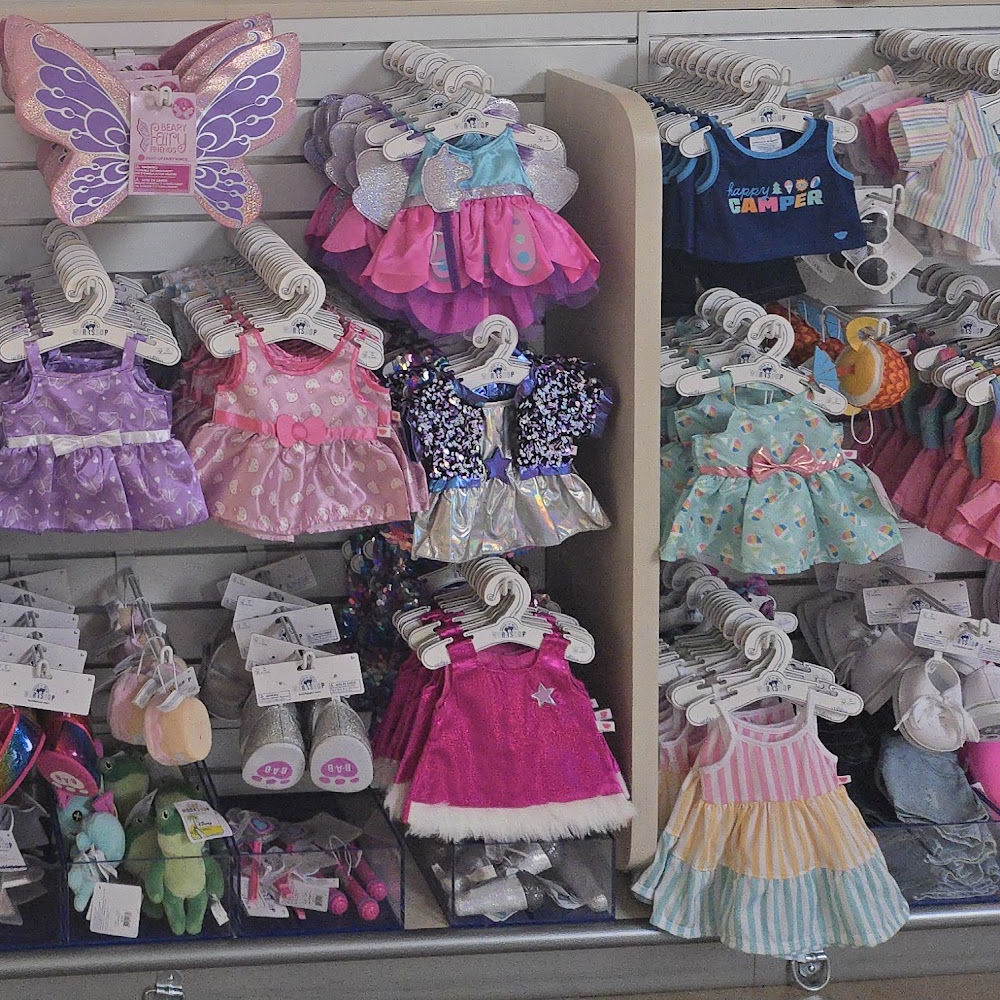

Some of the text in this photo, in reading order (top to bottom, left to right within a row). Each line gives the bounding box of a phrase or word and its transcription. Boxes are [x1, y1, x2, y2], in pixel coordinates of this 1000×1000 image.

[161, 124, 187, 133] BEARY
[150, 146, 177, 154] FRIENDS
[727, 182, 770, 198] happy
[728, 189, 824, 214] CAMPER
